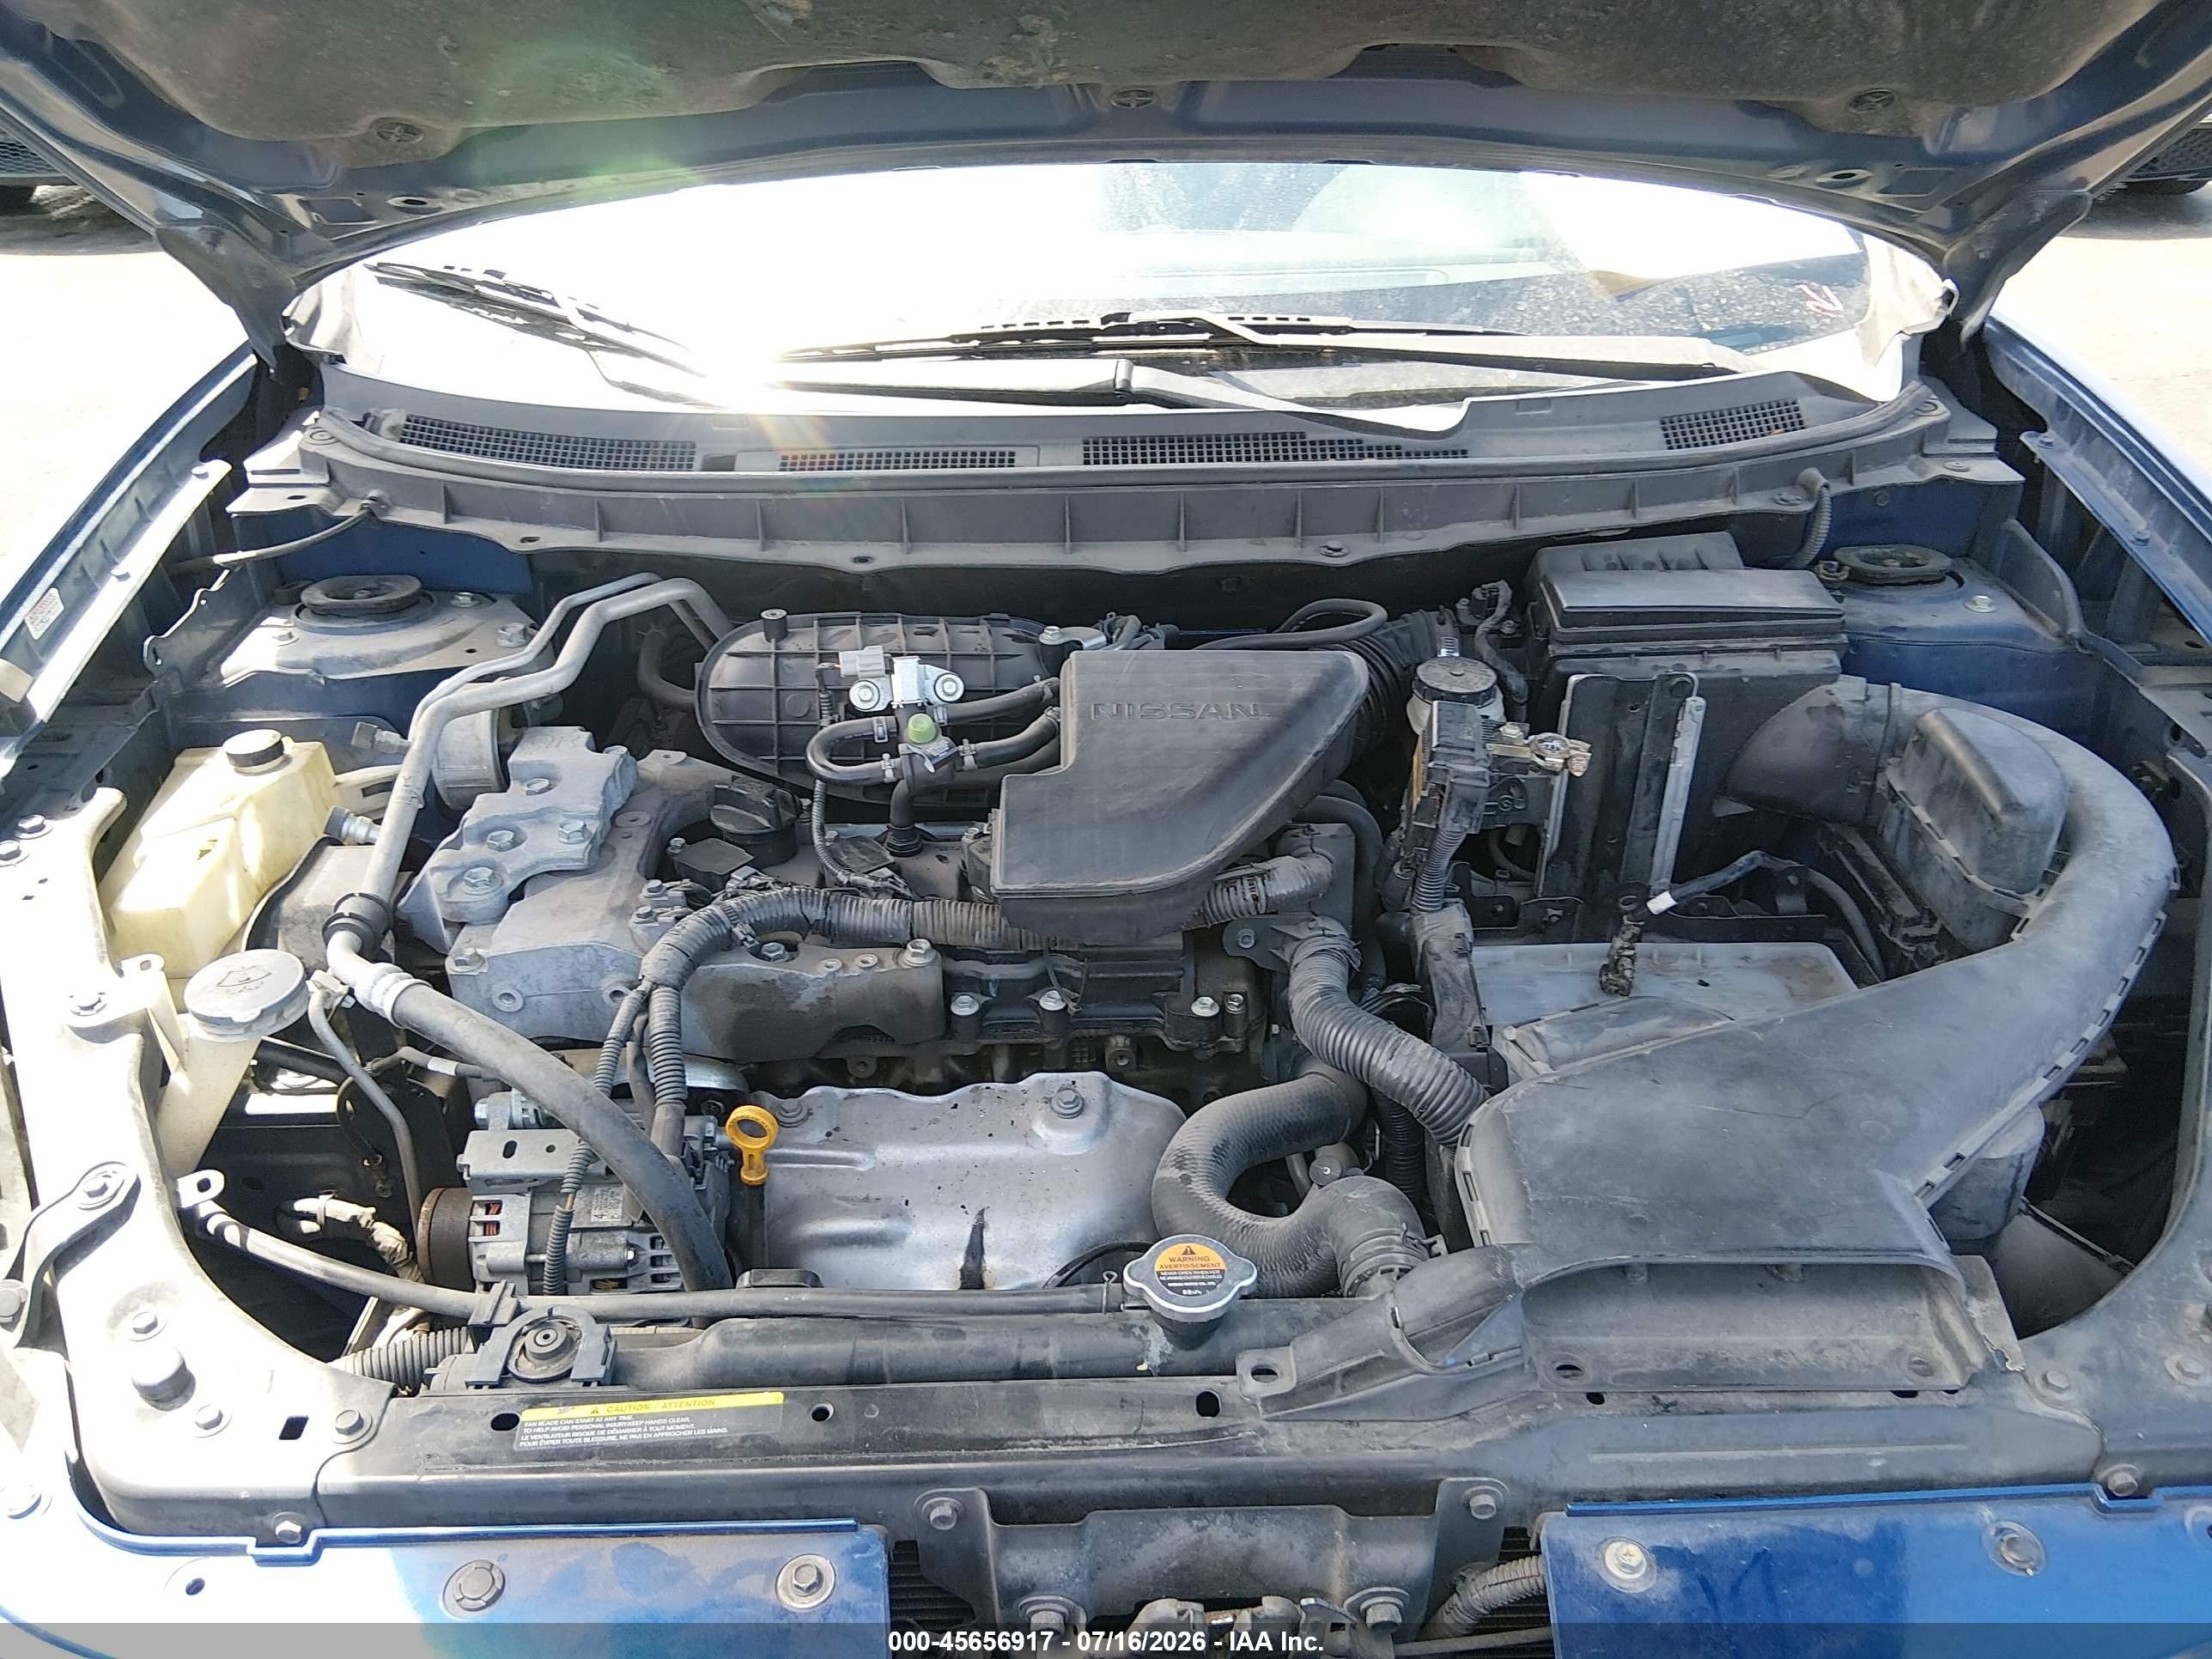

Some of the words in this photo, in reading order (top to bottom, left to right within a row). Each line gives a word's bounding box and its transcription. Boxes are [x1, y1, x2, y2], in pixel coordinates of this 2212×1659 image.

[1091, 702, 1261, 721] NISSAN
[606, 1404, 651, 1413] CAUTION
[661, 1399, 715, 1408] ATTENTION
[571, 1422, 605, 1431] PERSONAL
[530, 1431, 571, 1440] VENTILATEUR
[653, 1429, 694, 1438] APPROCHER
